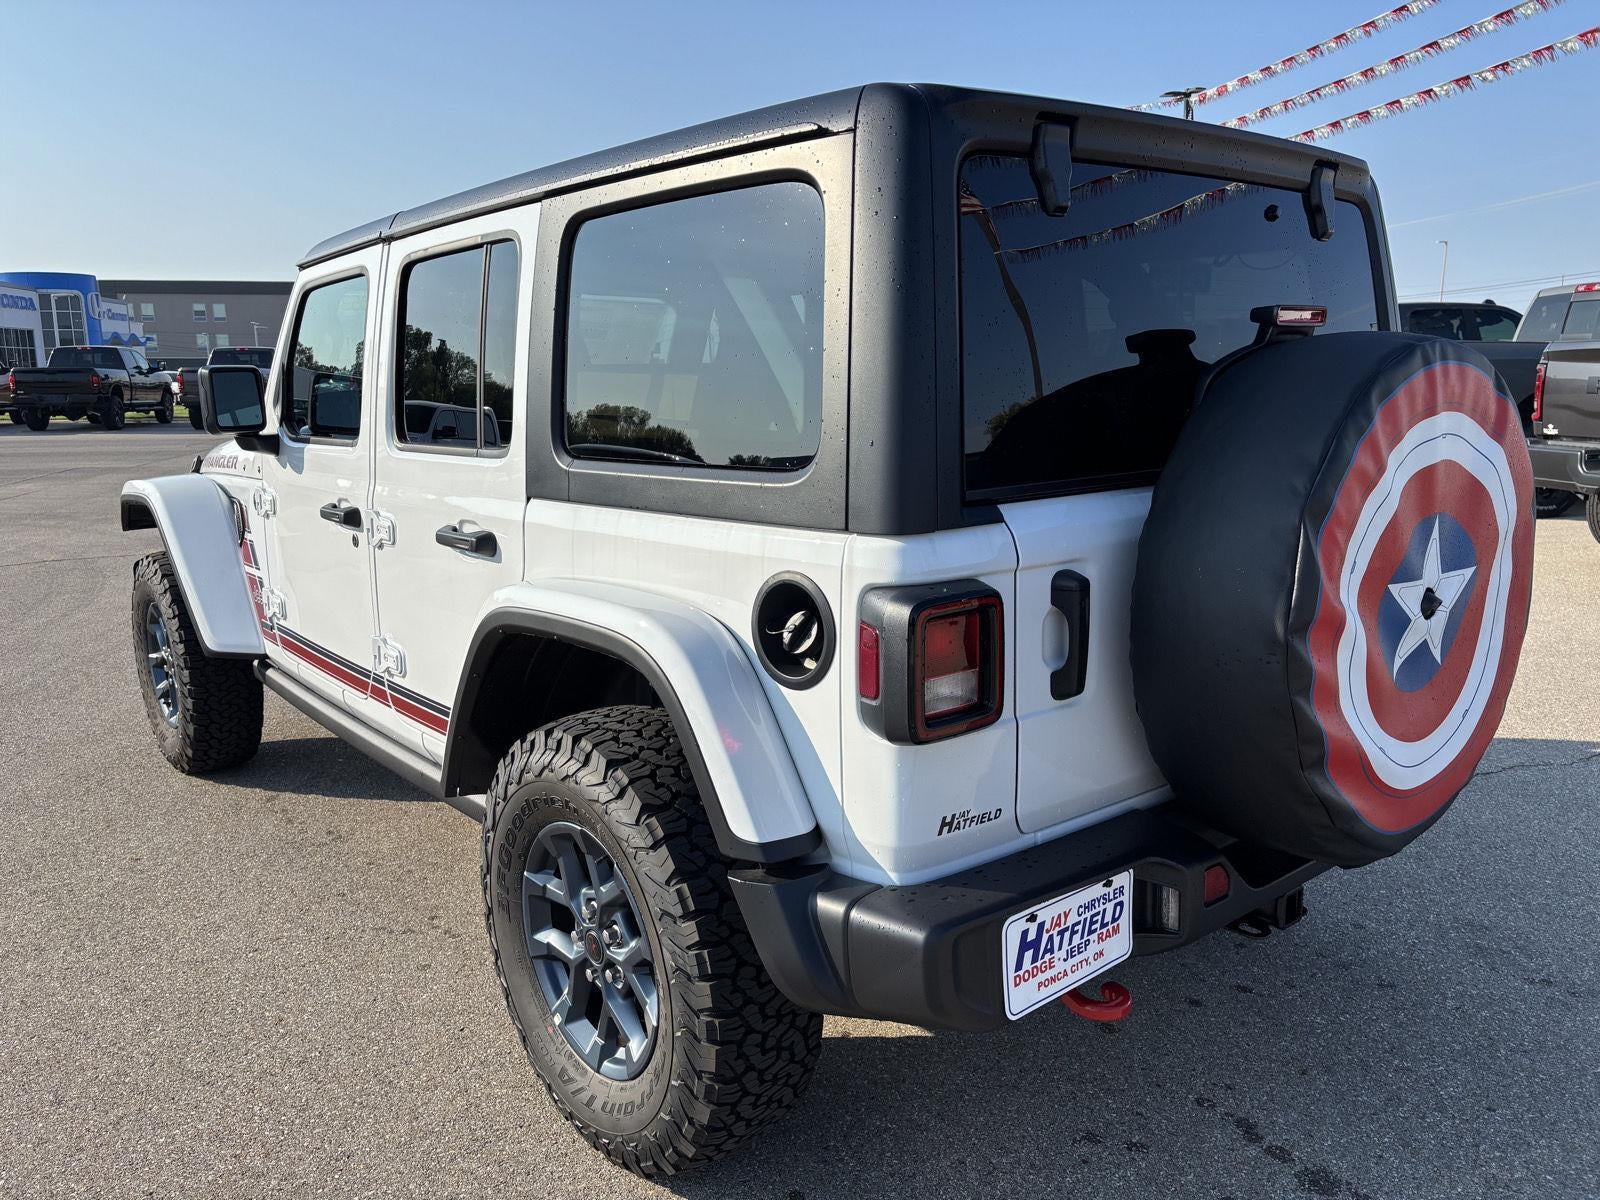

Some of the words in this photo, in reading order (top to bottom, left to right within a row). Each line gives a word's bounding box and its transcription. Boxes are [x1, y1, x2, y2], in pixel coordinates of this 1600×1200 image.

[0, 294, 37, 311] ONDA
[205, 455, 239, 469] RANGLER
[937, 807, 1003, 837] HATFIELD
[956, 808, 972, 820] JAY
[1045, 908, 1073, 934] JAY
[1077, 885, 1125, 917] CHRYSLER
[1014, 900, 1125, 974] HATFIELD
[1013, 956, 1056, 988] DODGE
[1062, 939, 1091, 963] JEEP
[1097, 924, 1121, 945] RAM
[1037, 970, 1069, 991] PONCA
[1070, 957, 1092, 975] CITY,
[1093, 949, 1105, 962] OK
